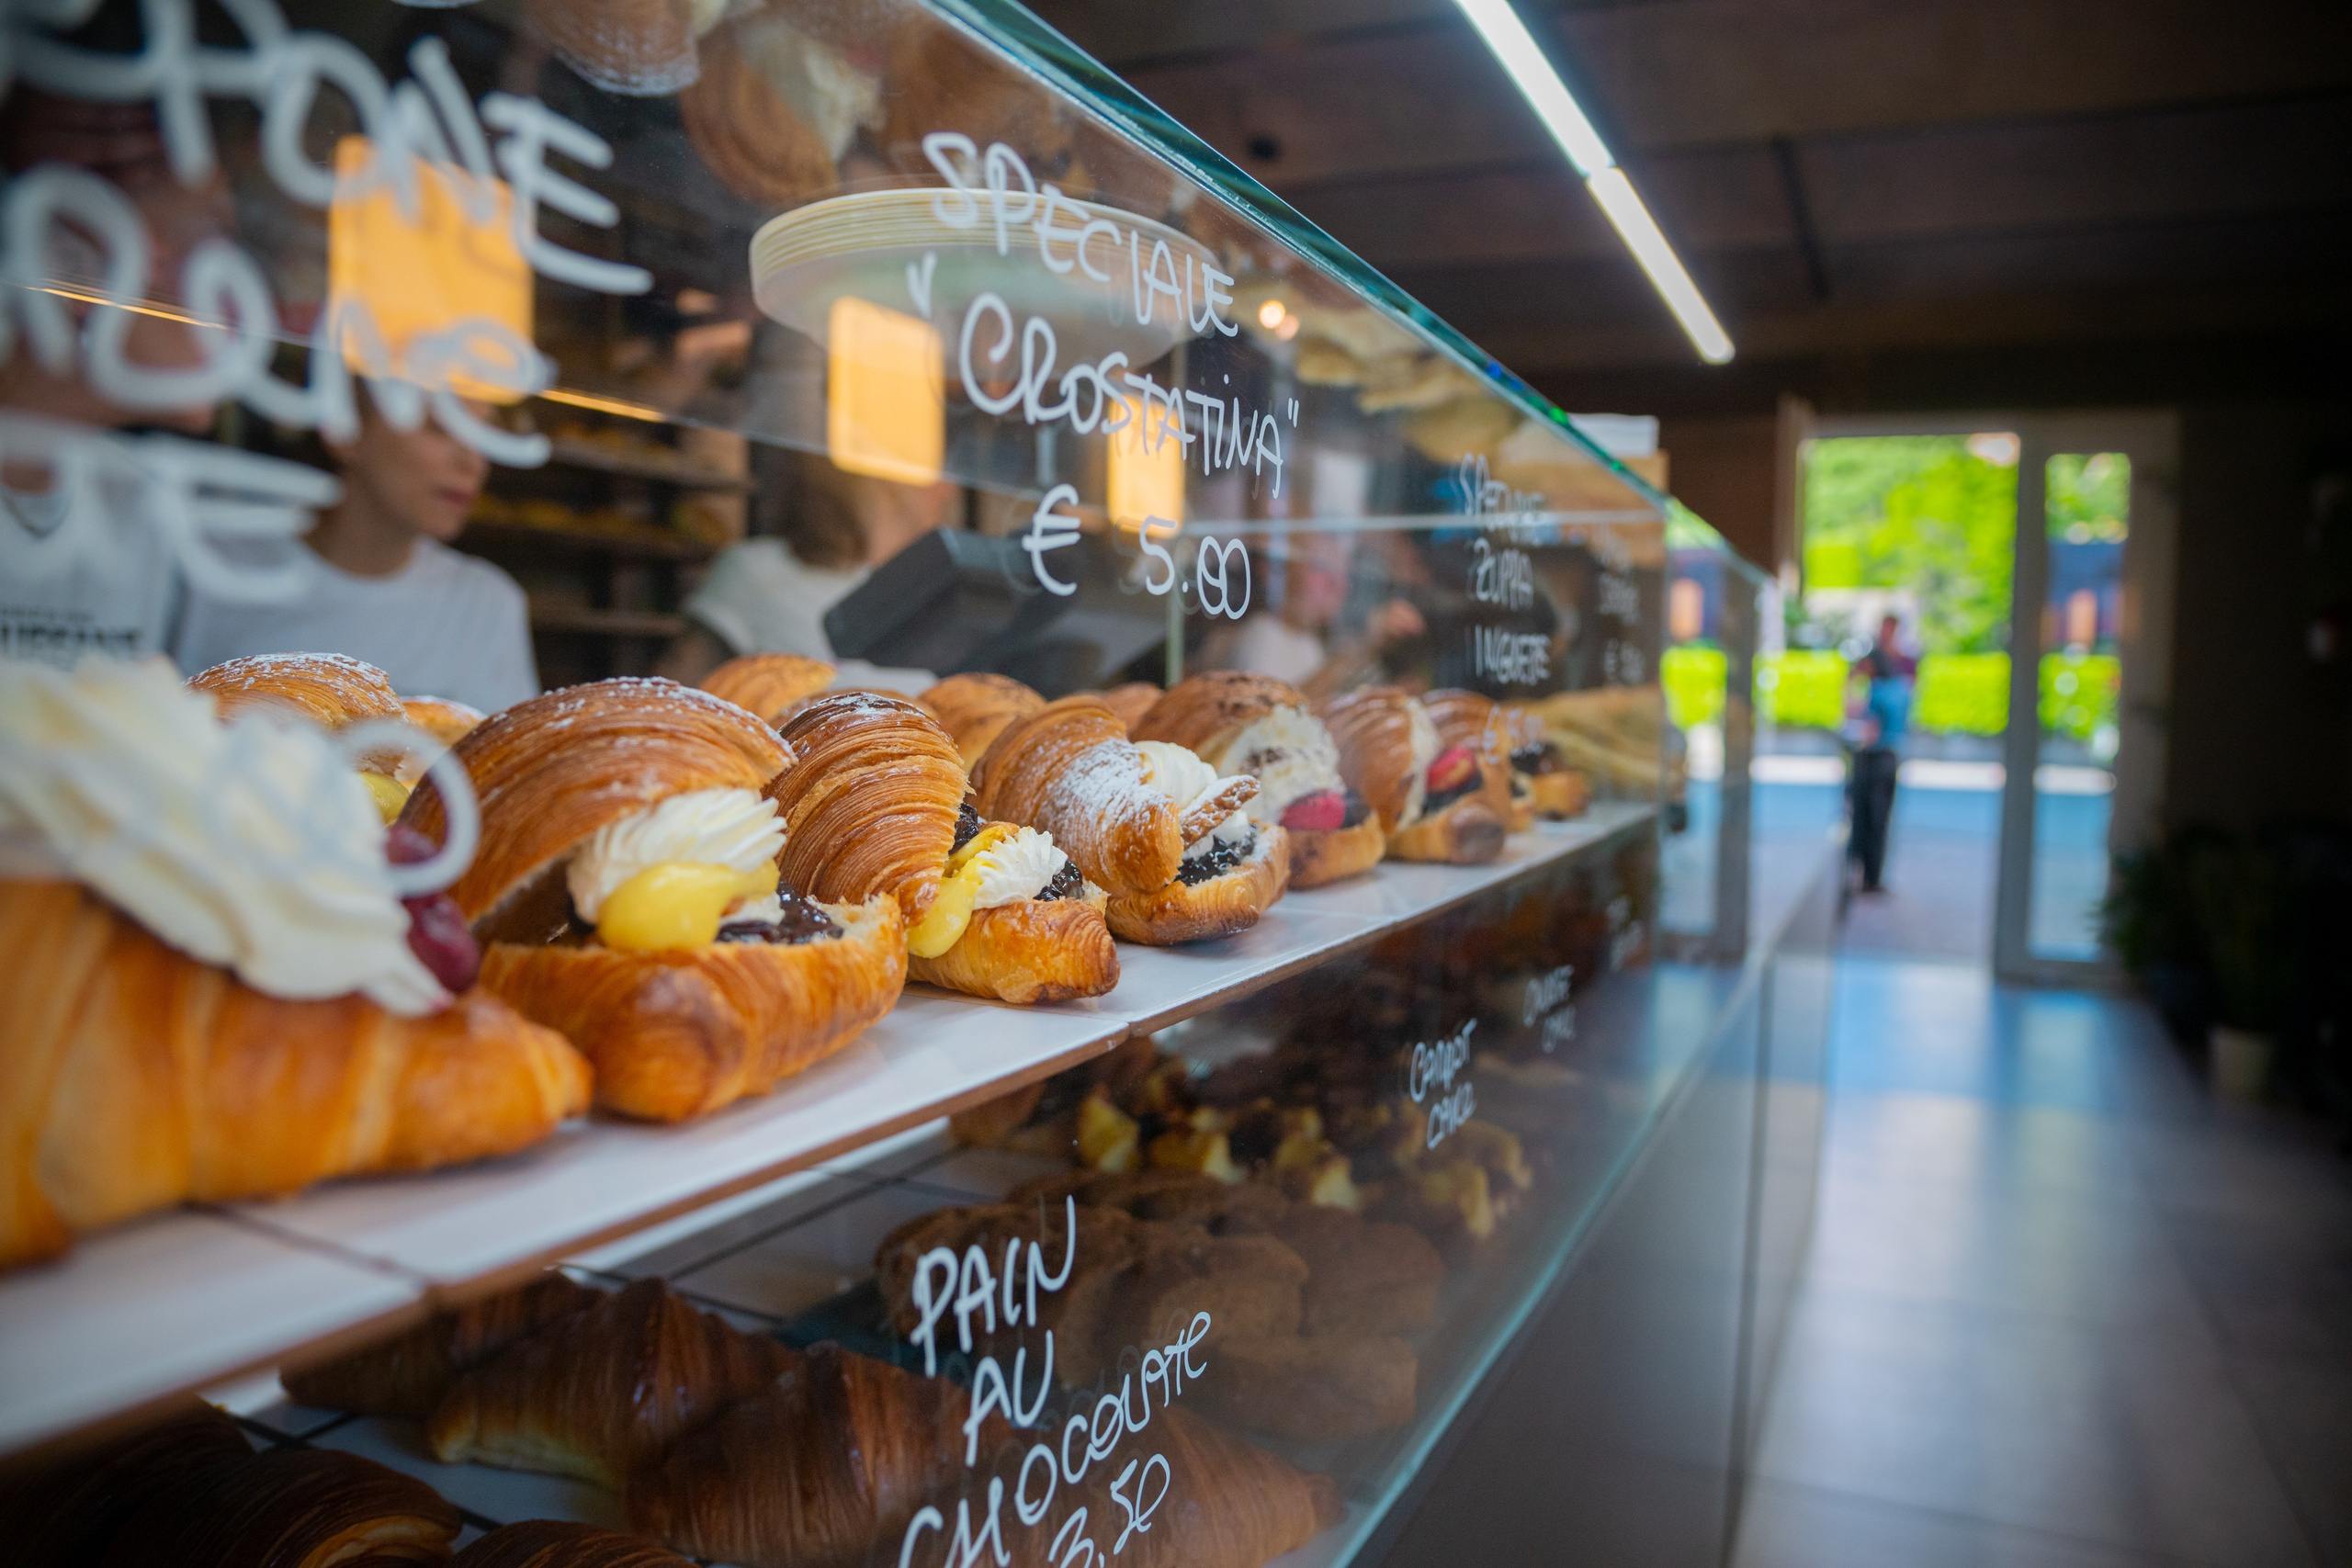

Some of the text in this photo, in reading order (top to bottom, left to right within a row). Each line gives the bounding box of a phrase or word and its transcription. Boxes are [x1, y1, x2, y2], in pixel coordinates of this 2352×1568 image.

[923, 131, 1238, 338] SPECIALE
[1023, 483, 1082, 596] €
[910, 1194, 1076, 1377] PAIN
[963, 1329, 1055, 1467] AU
